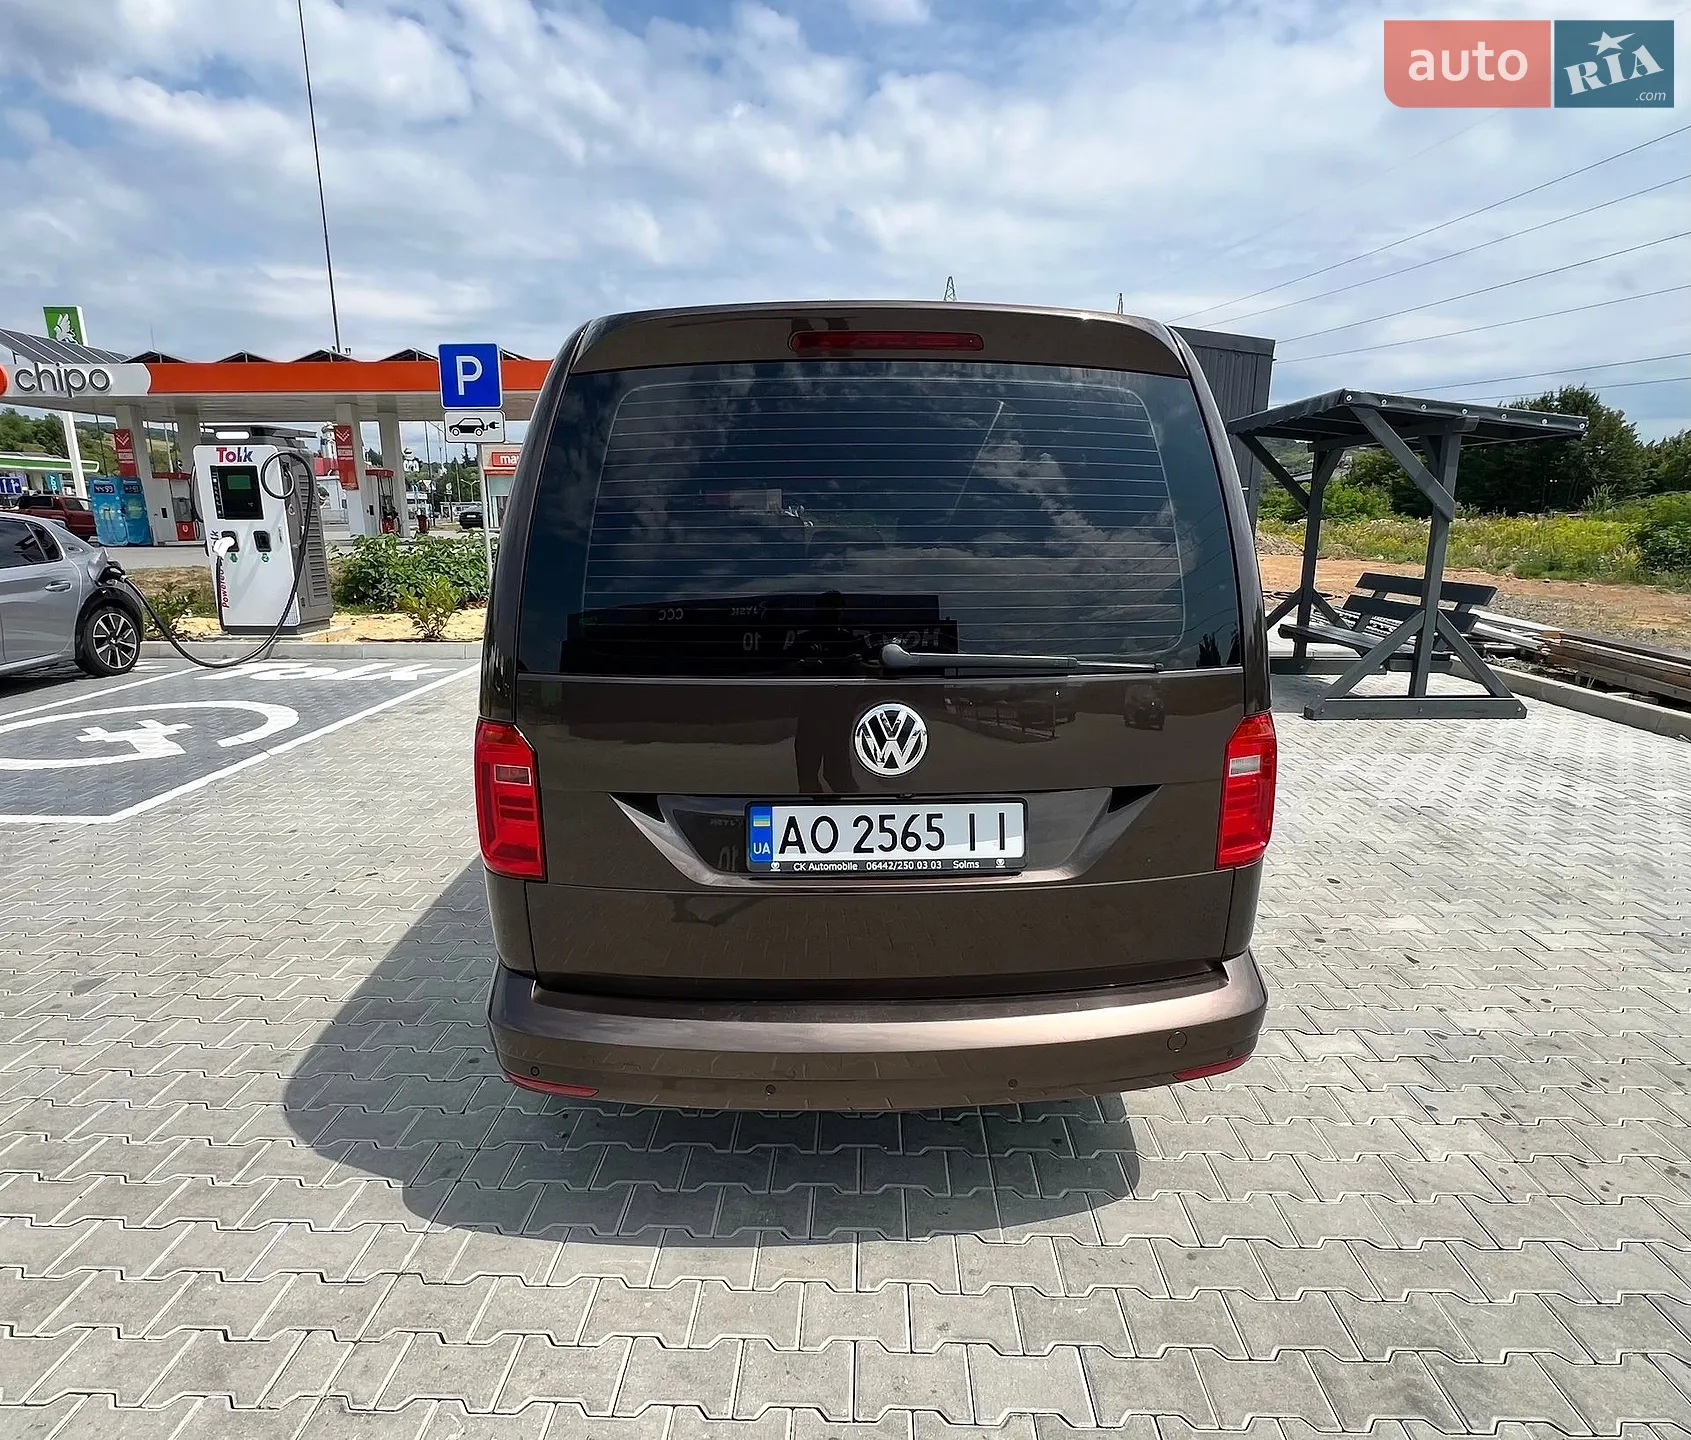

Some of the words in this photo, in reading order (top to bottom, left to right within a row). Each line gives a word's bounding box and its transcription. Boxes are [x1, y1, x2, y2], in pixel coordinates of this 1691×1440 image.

[15, 362, 111, 398] chipo
[456, 355, 483, 396] P
[216, 446, 253, 463] Tolk
[500, 455, 520, 465] ma
[778, 815, 839, 854] AO
[852, 813, 945, 854] 2565
[753, 842, 771, 855] UA
[793, 863, 807, 872] CK
[808, 861, 858, 871] Automobile
[866, 860, 915, 871] 06442/250
[916, 861, 929, 870] 03
[930, 861, 942, 870] 03
[952, 860, 980, 869] Solms
